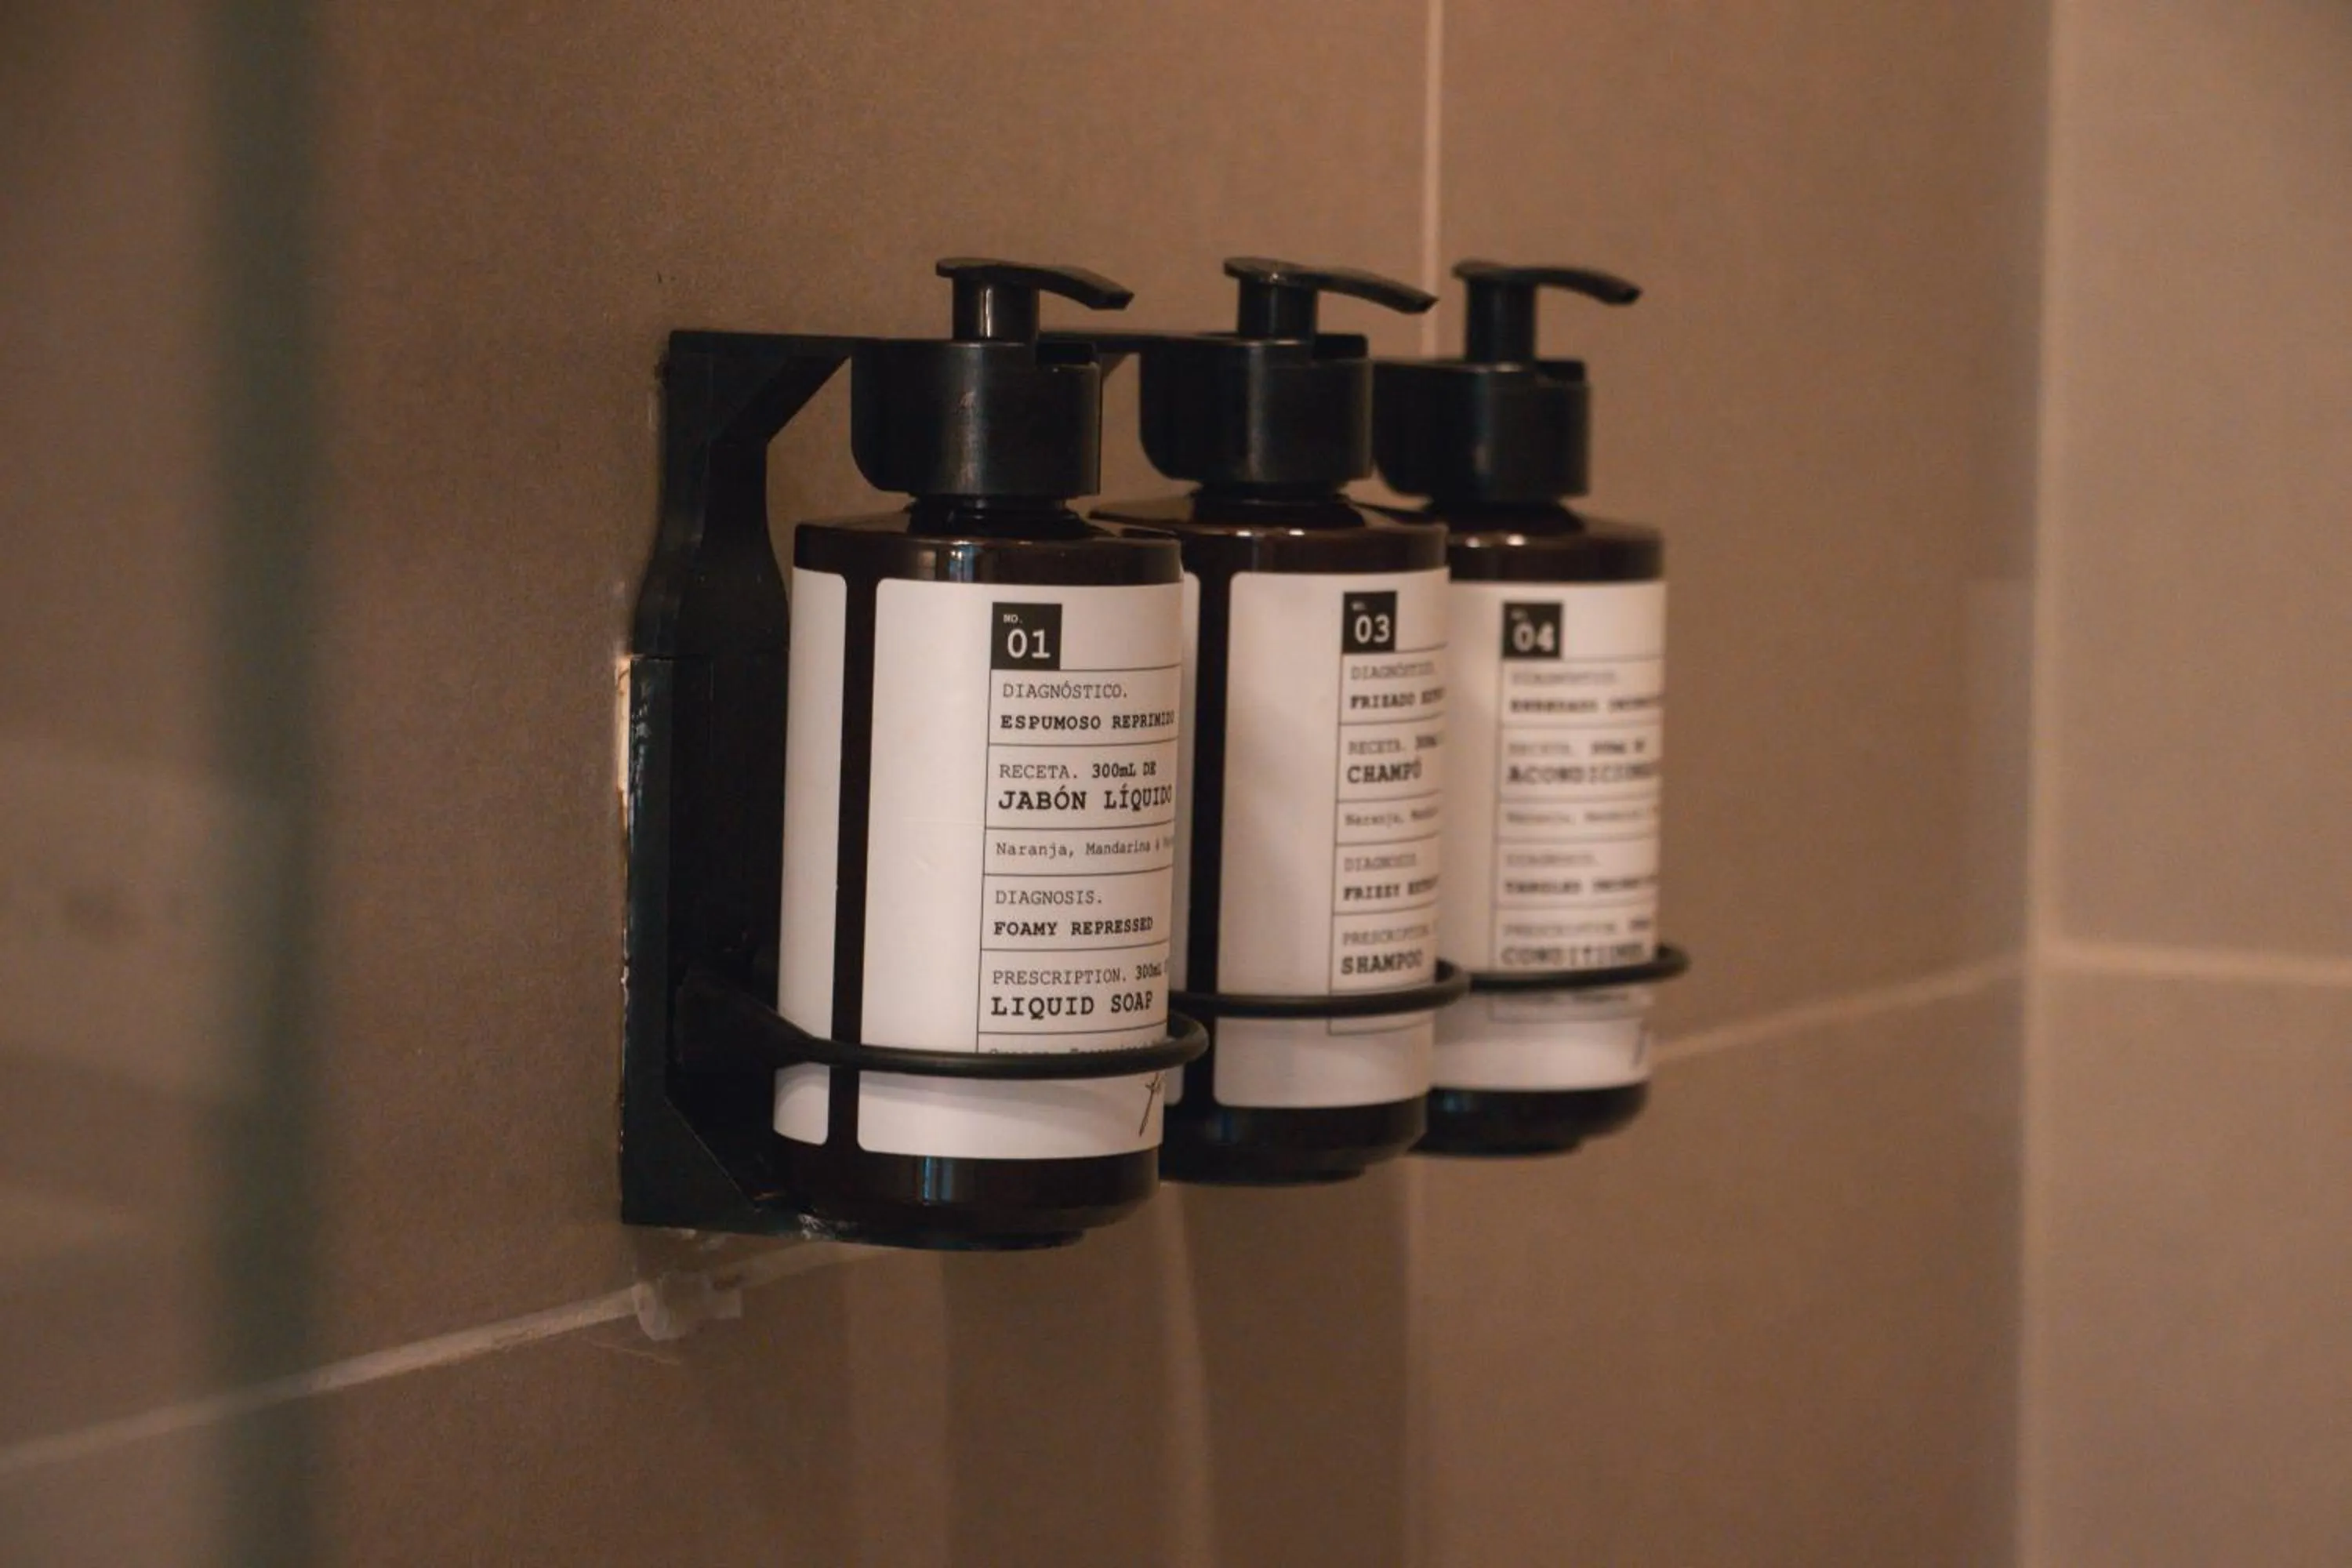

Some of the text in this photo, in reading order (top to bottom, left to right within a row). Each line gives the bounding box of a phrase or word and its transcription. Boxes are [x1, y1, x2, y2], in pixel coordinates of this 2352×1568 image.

[1004, 614, 1022, 623] NO.
[1355, 614, 1391, 644] 03
[1512, 622, 1555, 652] 04
[1007, 628, 1051, 659] 01
[1003, 681, 1128, 699] DIAGNÓSTICO.
[1000, 710, 1175, 730] ESPUMOSO REPRIMIDO
[999, 760, 1157, 779] RECETA. 300mL DE
[998, 782, 1173, 811] JABÓN LÍQUIDO
[996, 841, 1075, 859] Naranja,
[1085, 839, 1151, 855] Mandarina
[995, 889, 1103, 906] DIAGNOSIS.
[993, 915, 1154, 936] FOAMY REPRESSED
[993, 967, 1127, 986] PRESCRIPTION.
[991, 990, 1153, 1020] LIQUID SOAP
